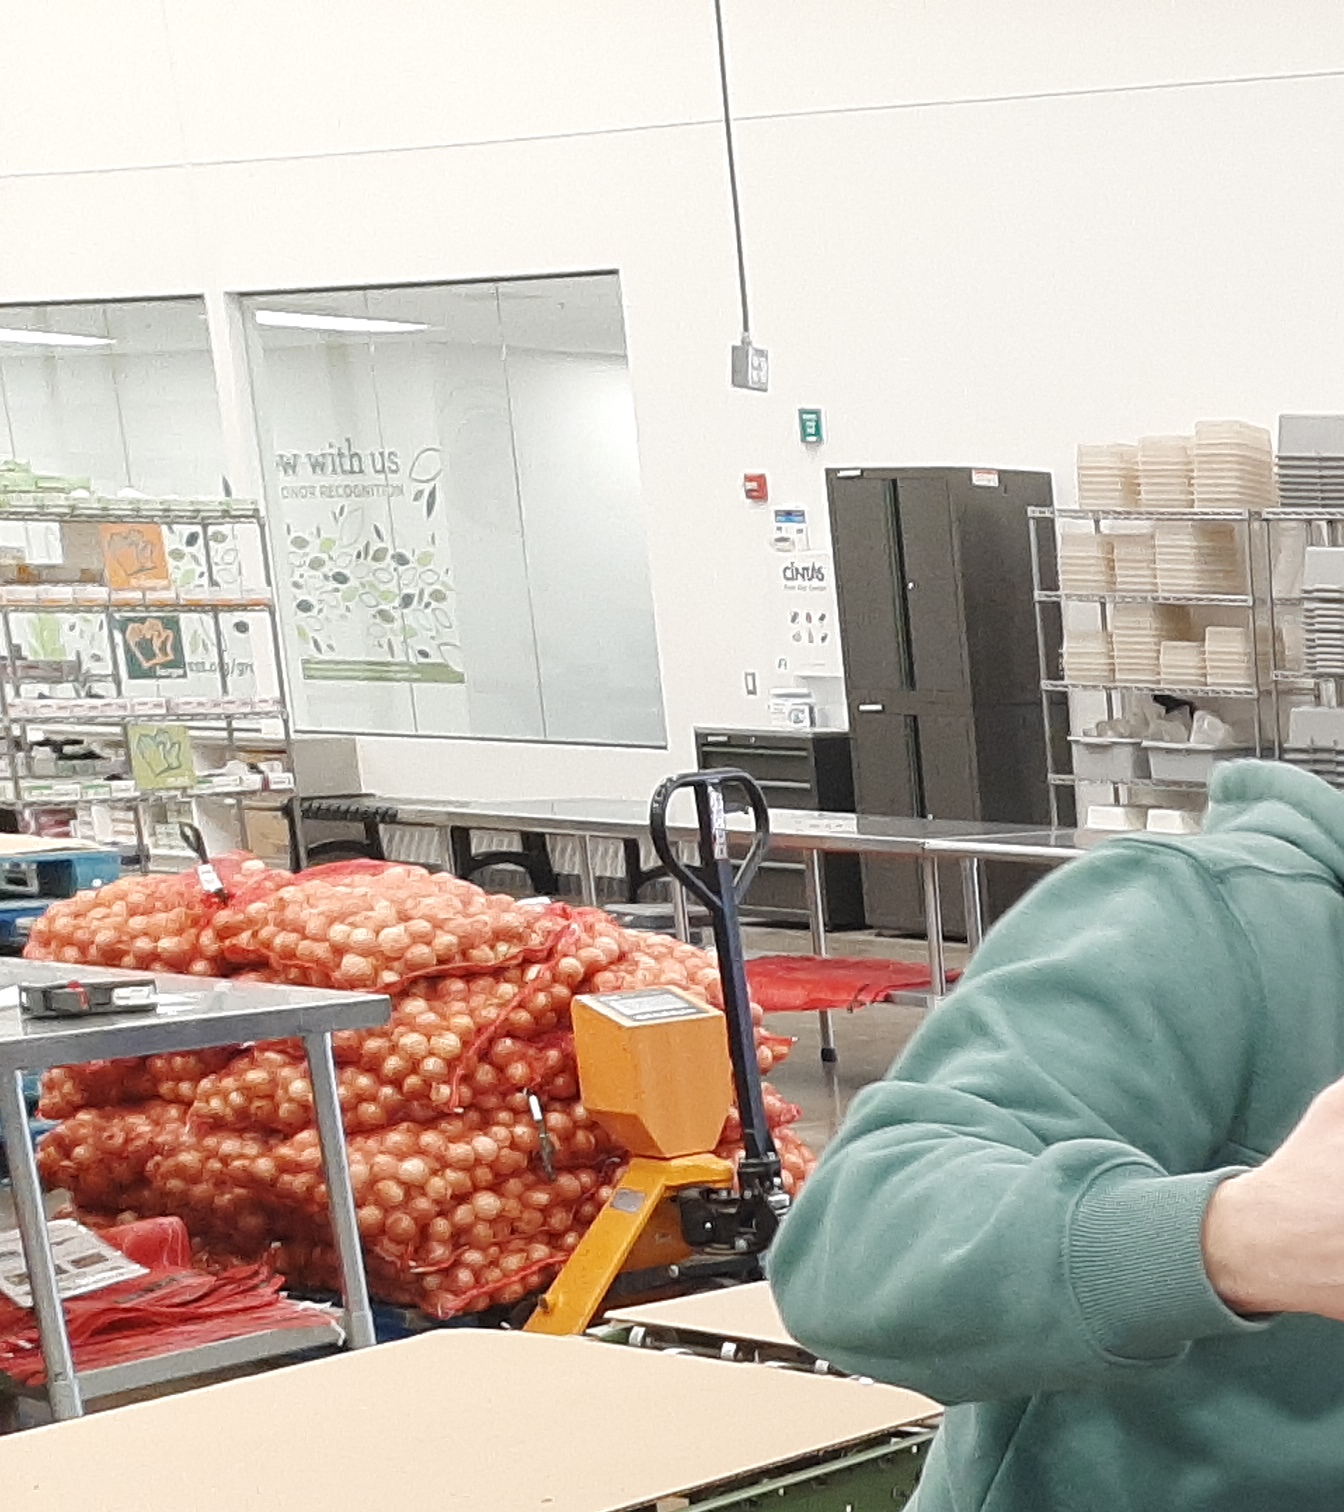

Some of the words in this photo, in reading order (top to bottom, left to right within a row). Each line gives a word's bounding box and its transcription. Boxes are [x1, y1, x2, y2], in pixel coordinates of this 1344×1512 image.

[306, 437, 365, 475] with
[369, 449, 400, 475] us
[319, 483, 404, 498] RECOGNITION
